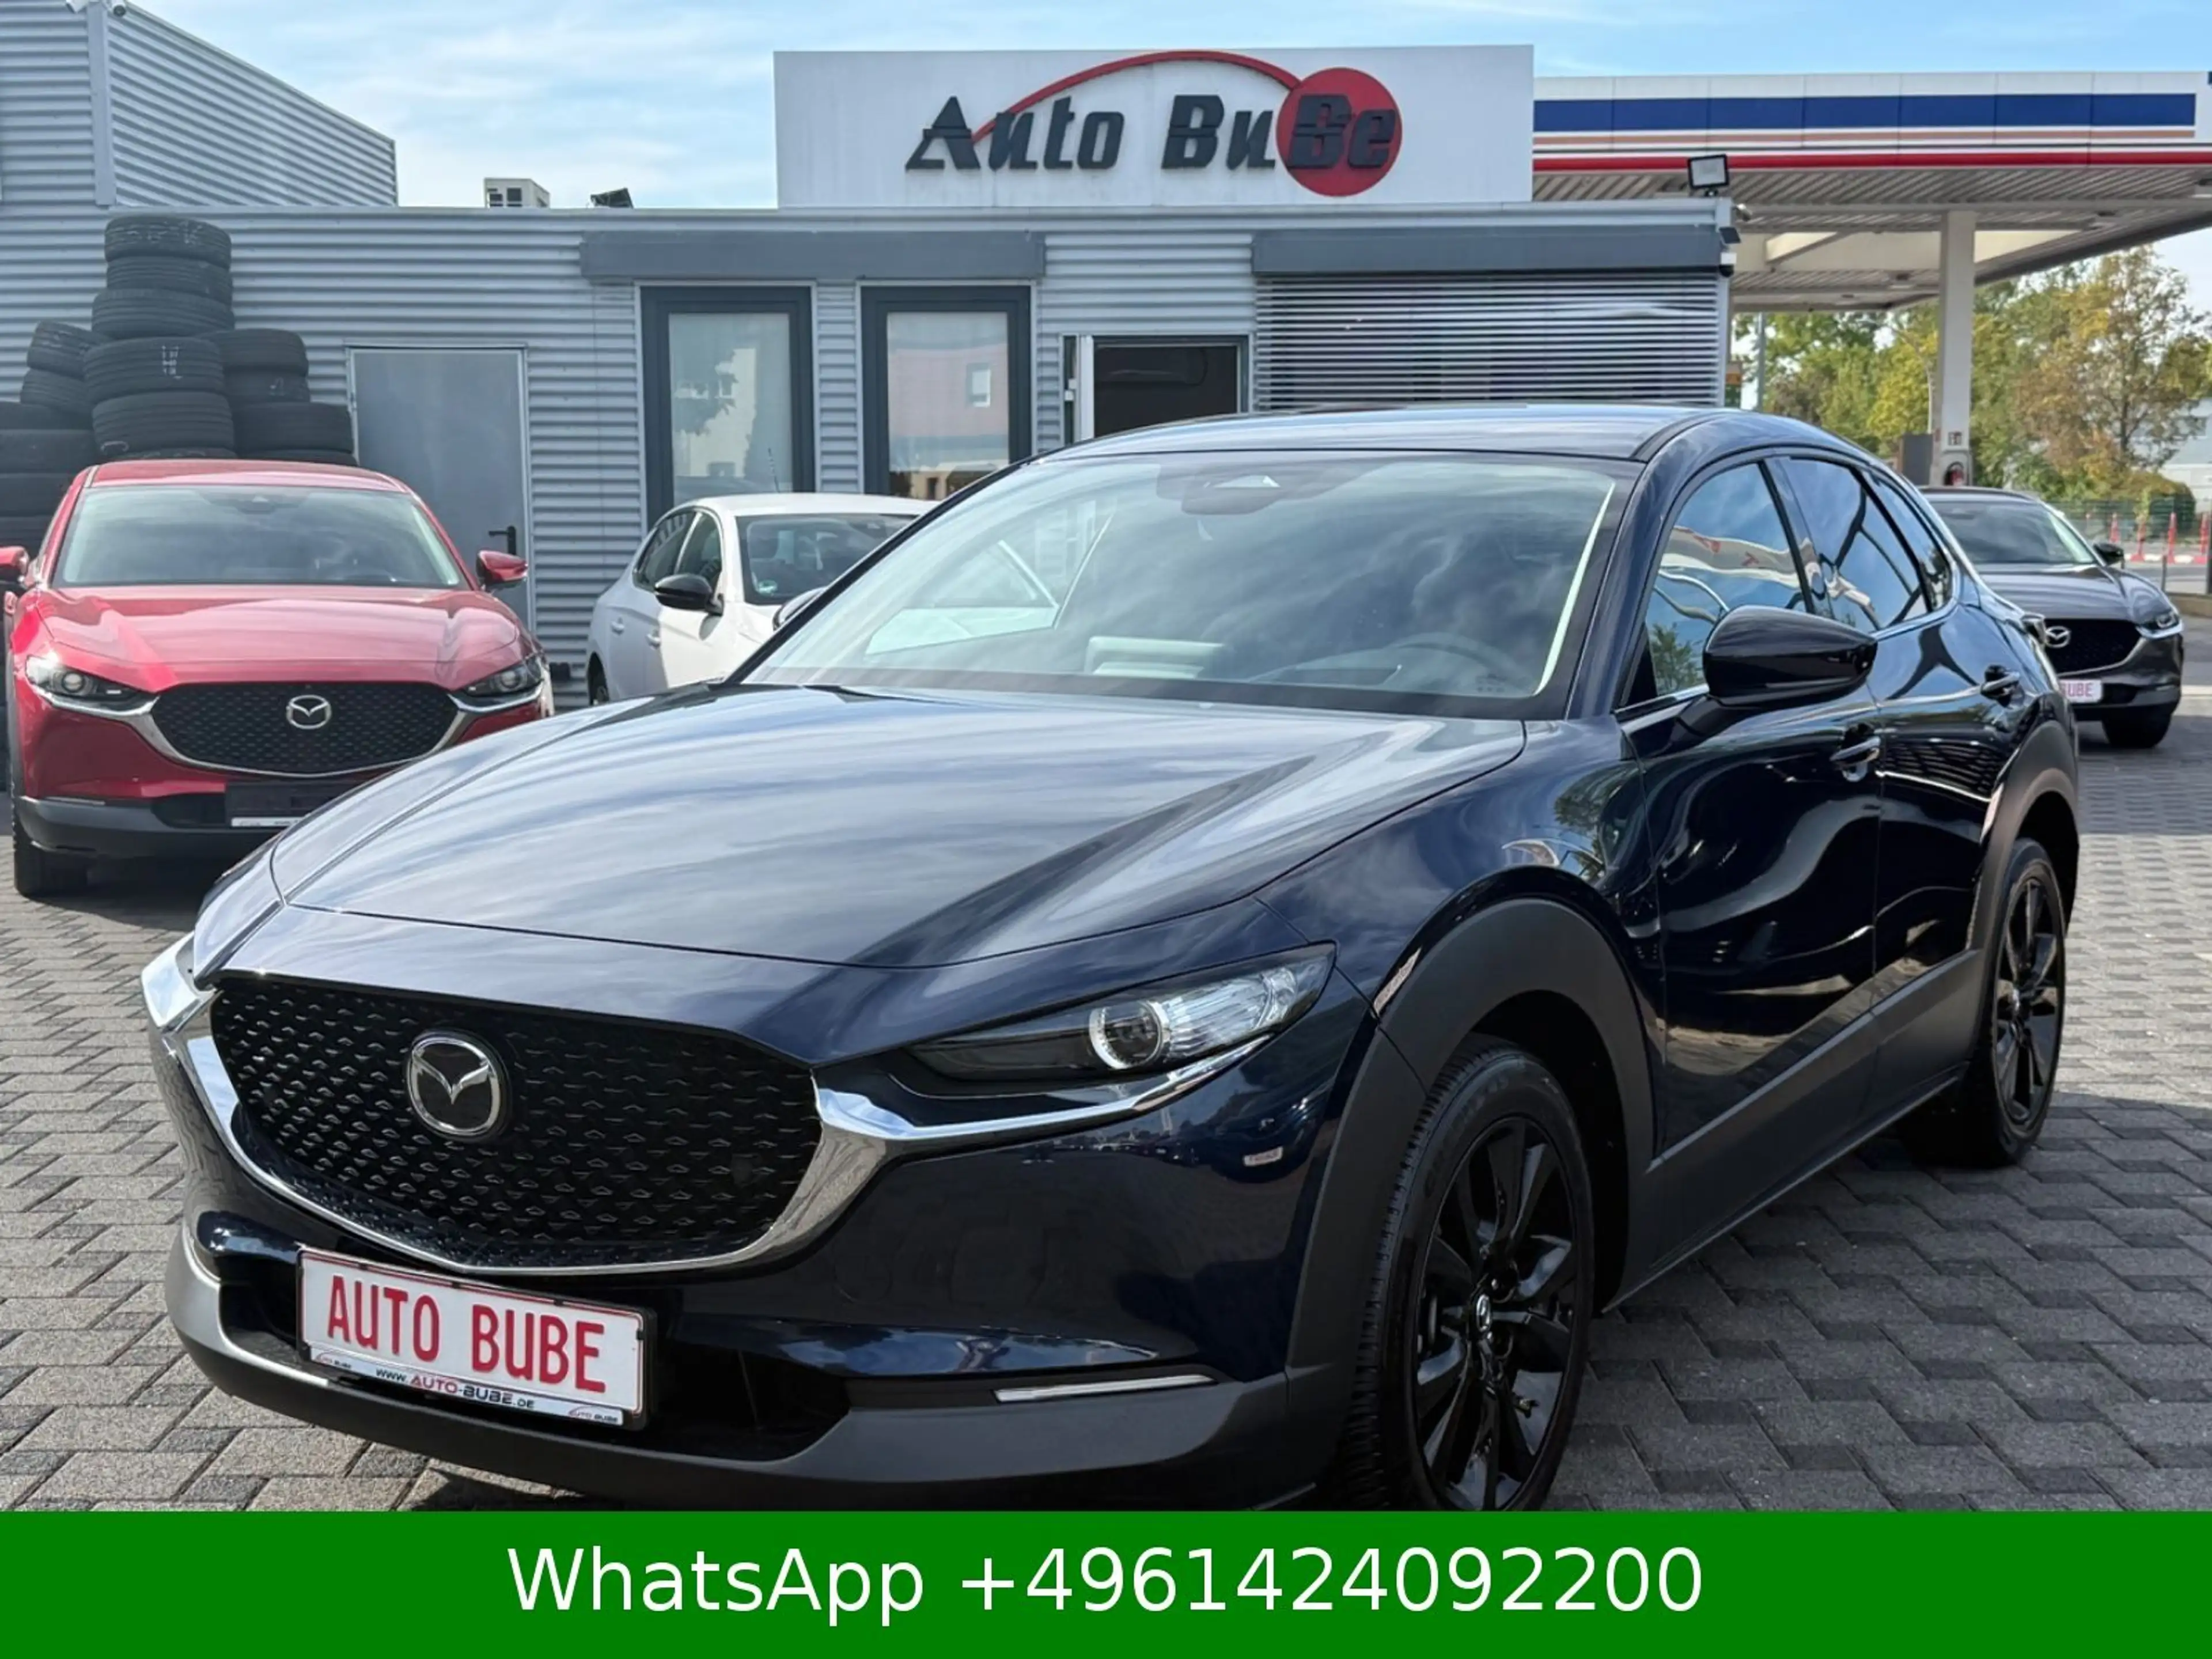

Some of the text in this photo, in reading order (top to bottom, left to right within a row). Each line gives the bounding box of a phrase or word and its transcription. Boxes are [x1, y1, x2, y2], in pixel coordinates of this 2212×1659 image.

[905, 95, 1125, 171] Auto
[328, 1275, 605, 1393] AUTO BUBE
